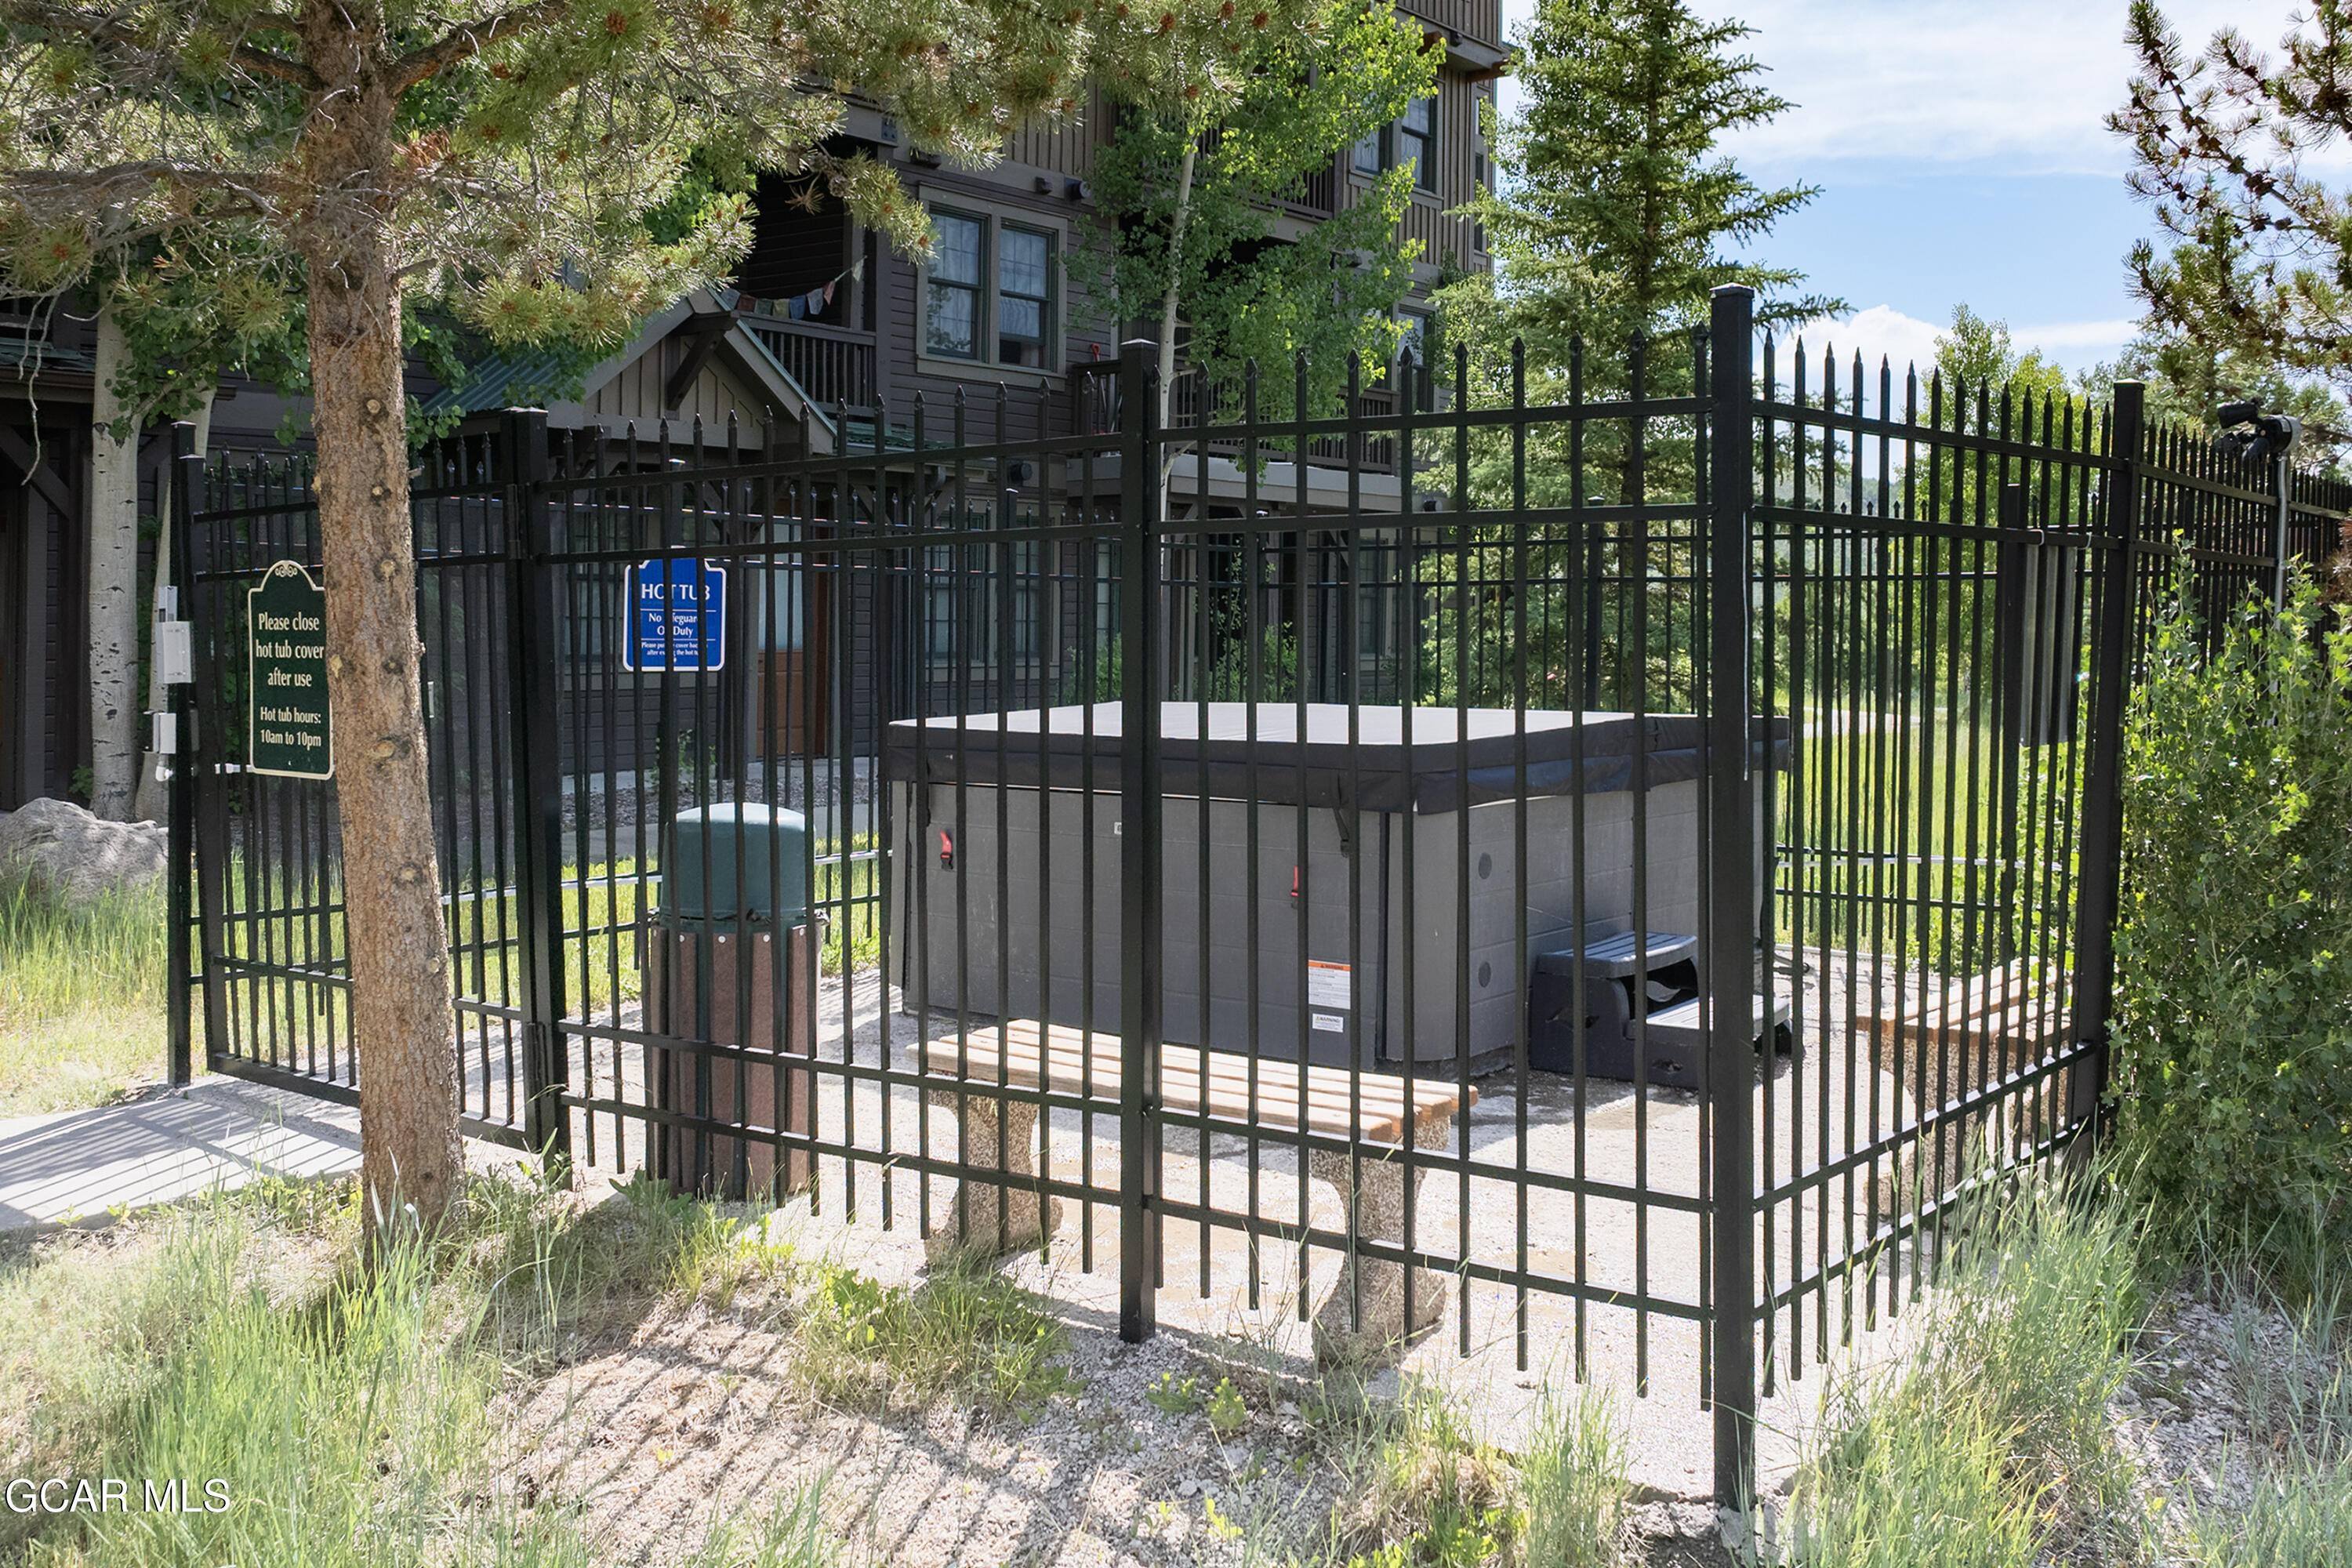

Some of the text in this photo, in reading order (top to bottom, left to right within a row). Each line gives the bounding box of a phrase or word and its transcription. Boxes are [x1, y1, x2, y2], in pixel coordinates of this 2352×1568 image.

[259, 612, 320, 631] Please close
[648, 612, 662, 622] No
[256, 639, 325, 659] hot tub cover
[267, 666, 312, 688] after use
[260, 706, 321, 724] Hot tub hours:
[260, 729, 321, 751] 10am to 10pm
